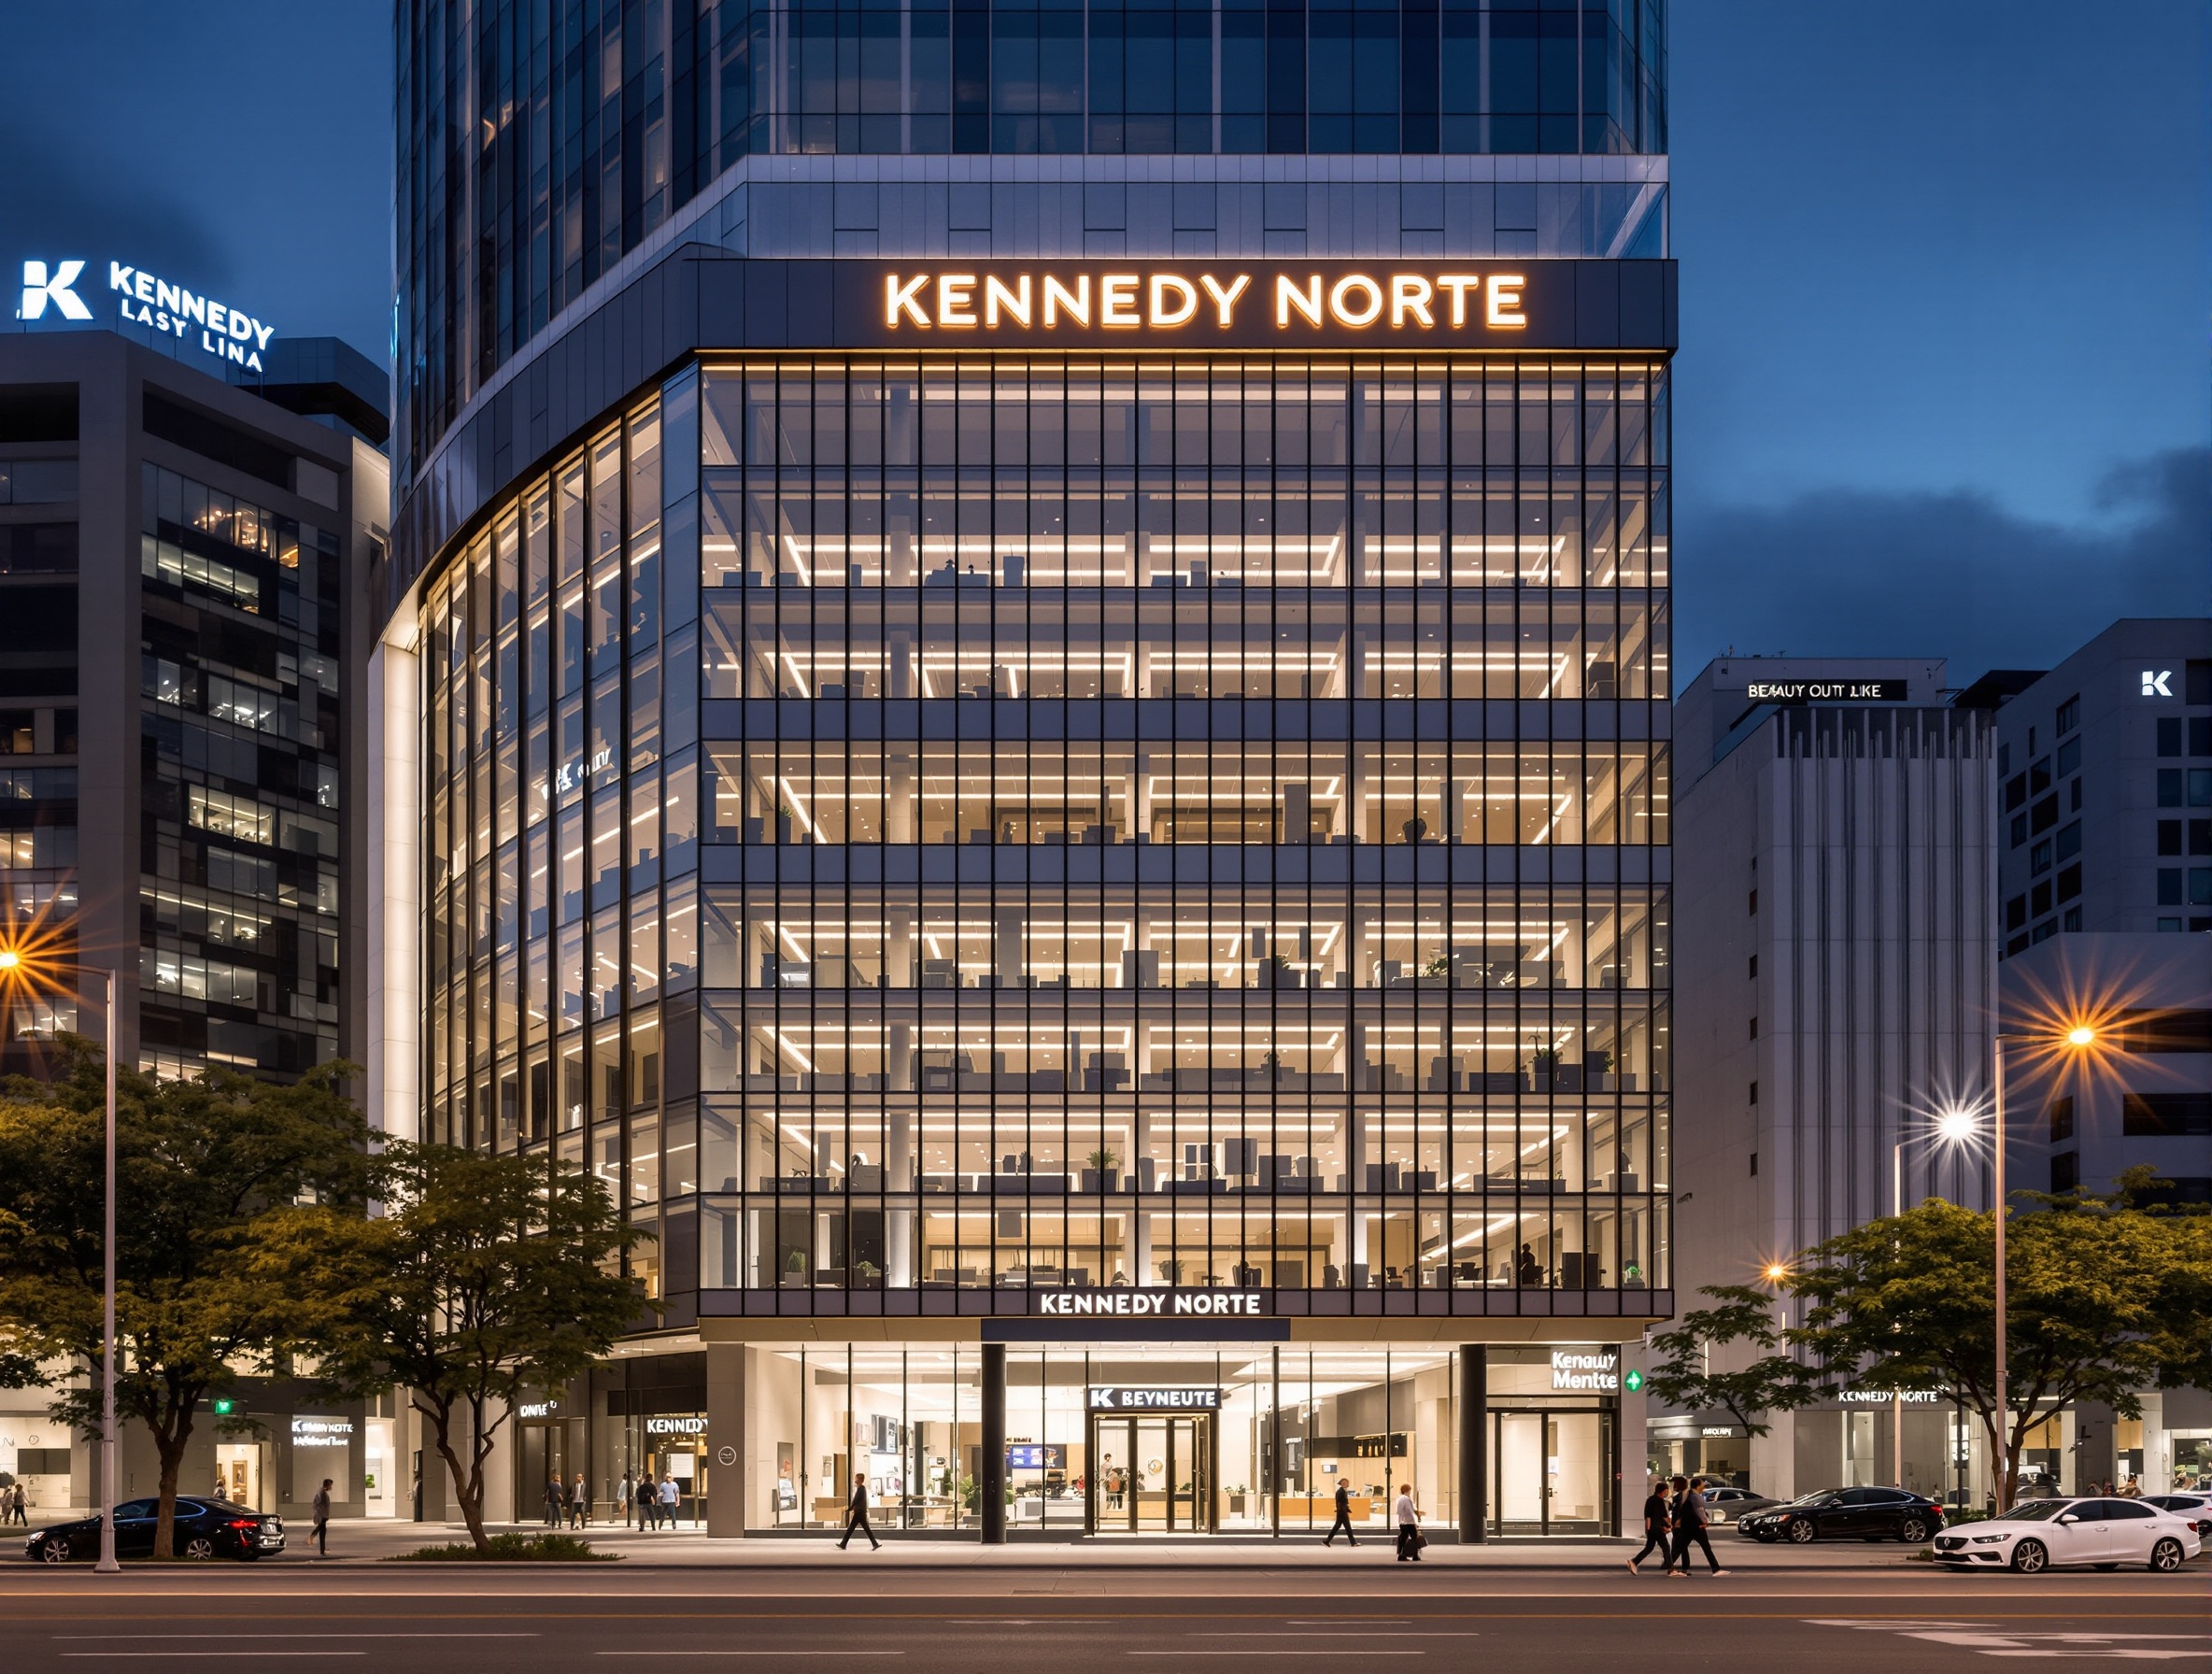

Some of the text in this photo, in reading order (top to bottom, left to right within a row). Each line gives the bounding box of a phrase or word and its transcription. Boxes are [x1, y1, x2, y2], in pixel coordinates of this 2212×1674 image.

[110, 262, 274, 350] KENNEDY
[886, 275, 1525, 328] KENNEDY NORTE
[121, 299, 262, 372] LASY LINA
[2142, 670, 2173, 697] K
[1042, 1294, 1261, 1314] KENNEDY NORTE
[1090, 1388, 1215, 1407] K BEYNEUTE
[1897, 1391, 1937, 1402] NORTE
